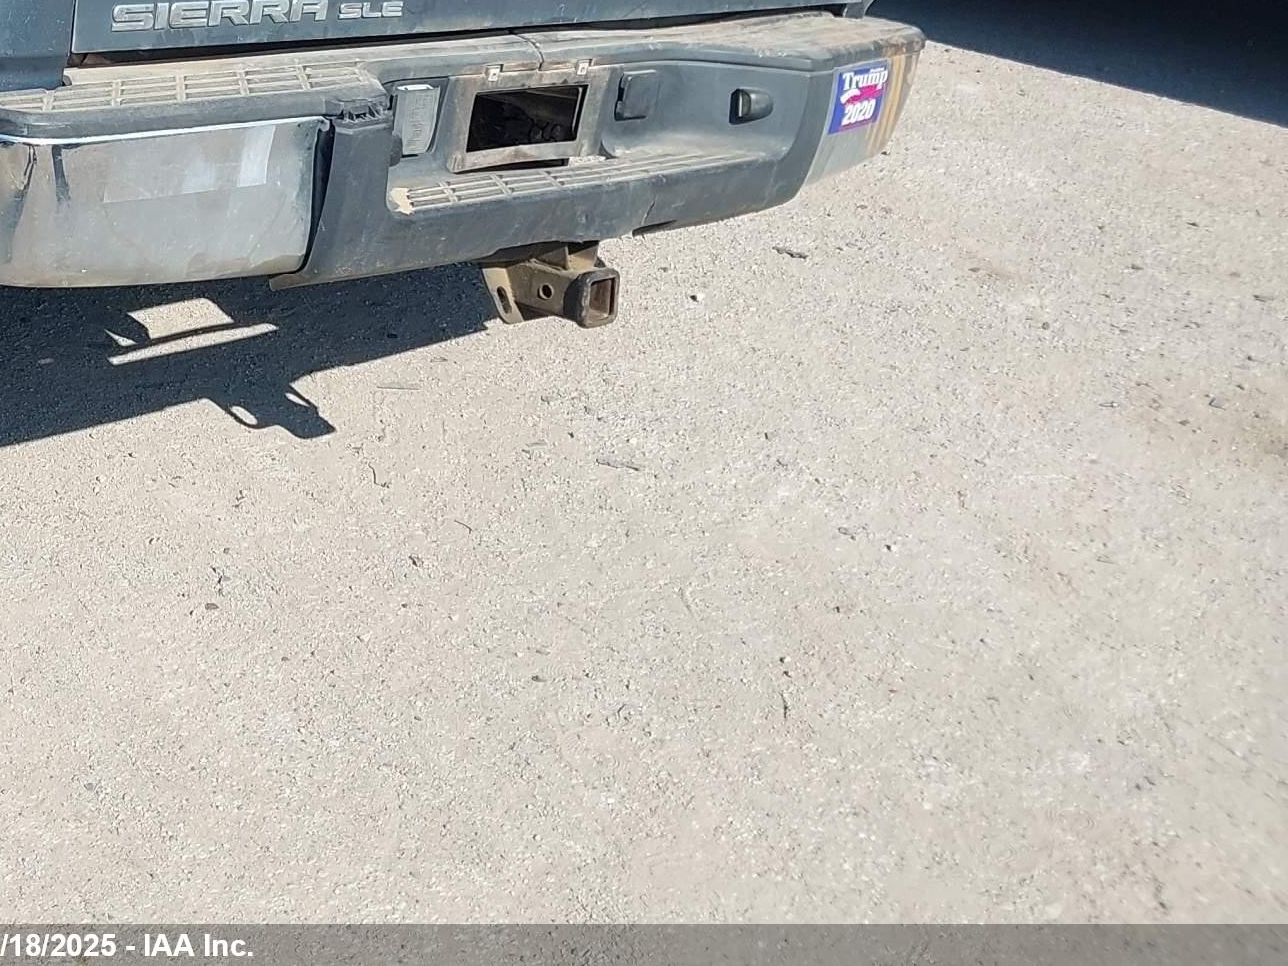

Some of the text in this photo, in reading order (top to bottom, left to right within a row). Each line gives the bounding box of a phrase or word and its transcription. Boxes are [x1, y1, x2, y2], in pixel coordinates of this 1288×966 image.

[338, 0, 404, 20] SLE
[842, 69, 889, 91] Trump
[841, 99, 876, 126] 2020
